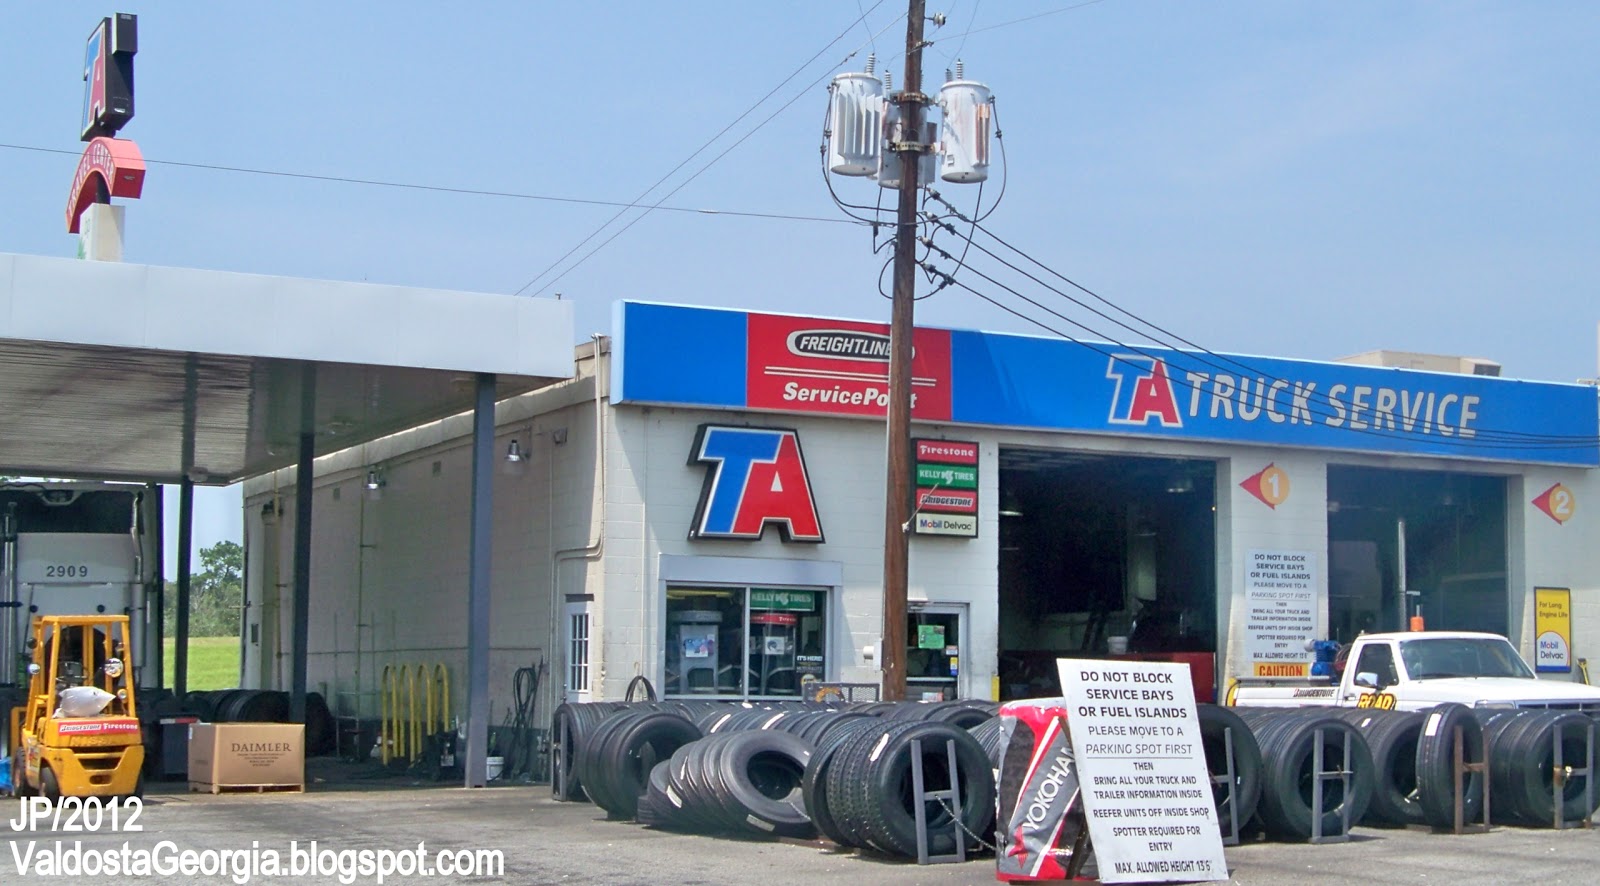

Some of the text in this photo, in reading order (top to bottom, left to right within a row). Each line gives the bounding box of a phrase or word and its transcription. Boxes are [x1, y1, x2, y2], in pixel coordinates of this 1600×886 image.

[92, 143, 115, 185] CENTER
[800, 336, 892, 356] FREIGHTLINE
[783, 382, 917, 408] ServicePot
[1106, 354, 1480, 437] TA TRUCK SERVICE
[920, 445, 974, 456] Firestone
[920, 470, 974, 480] KELLY TIRES
[697, 426, 822, 541] TA
[1268, 474, 1280, 498] 1
[920, 495, 972, 506] BRIDGESTONE
[1556, 490, 1570, 514] 2
[920, 520, 972, 530] Mobil Delvac
[46, 566, 88, 578] 2909
[1548, 602, 1562, 610] Long
[1539, 611, 1556, 619] Engine
[1540, 641, 1558, 649] Mobil
[1540, 650, 1564, 659] Delvac
[1259, 666, 1303, 676] CAUTION
[1080, 671, 1173, 683] DO NOT BLOCK
[1086, 688, 1173, 700] SERVICE BAYS
[1293, 688, 1335, 698] BRIDGESTONE
[1358, 692, 1394, 710] ROAD
[1078, 706, 1187, 718] OR FUEL ISLANDS
[1088, 726, 1183, 736] PLEASE MOVE TO A
[232, 743, 292, 752] DAIMLER
[1086, 744, 1192, 754] PARKING SPOT FIRST
[1134, 762, 1153, 770] THEN
[1094, 776, 1196, 785] BRING ALL YOUR TRUCK AND
[1094, 790, 1202, 799] TRAILER INFORMATION INSIDE
[1093, 808, 1209, 818] REEFER UNITS OFF INSIDE SHOP
[1113, 826, 1200, 836] SPOTTER REQUIRED FOR
[1149, 842, 1173, 851] ENTRY
[1114, 862, 1135, 873] MAX.
[1136, 862, 1169, 873] ALLOWED
[1171, 861, 1194, 872] HEIGHT
